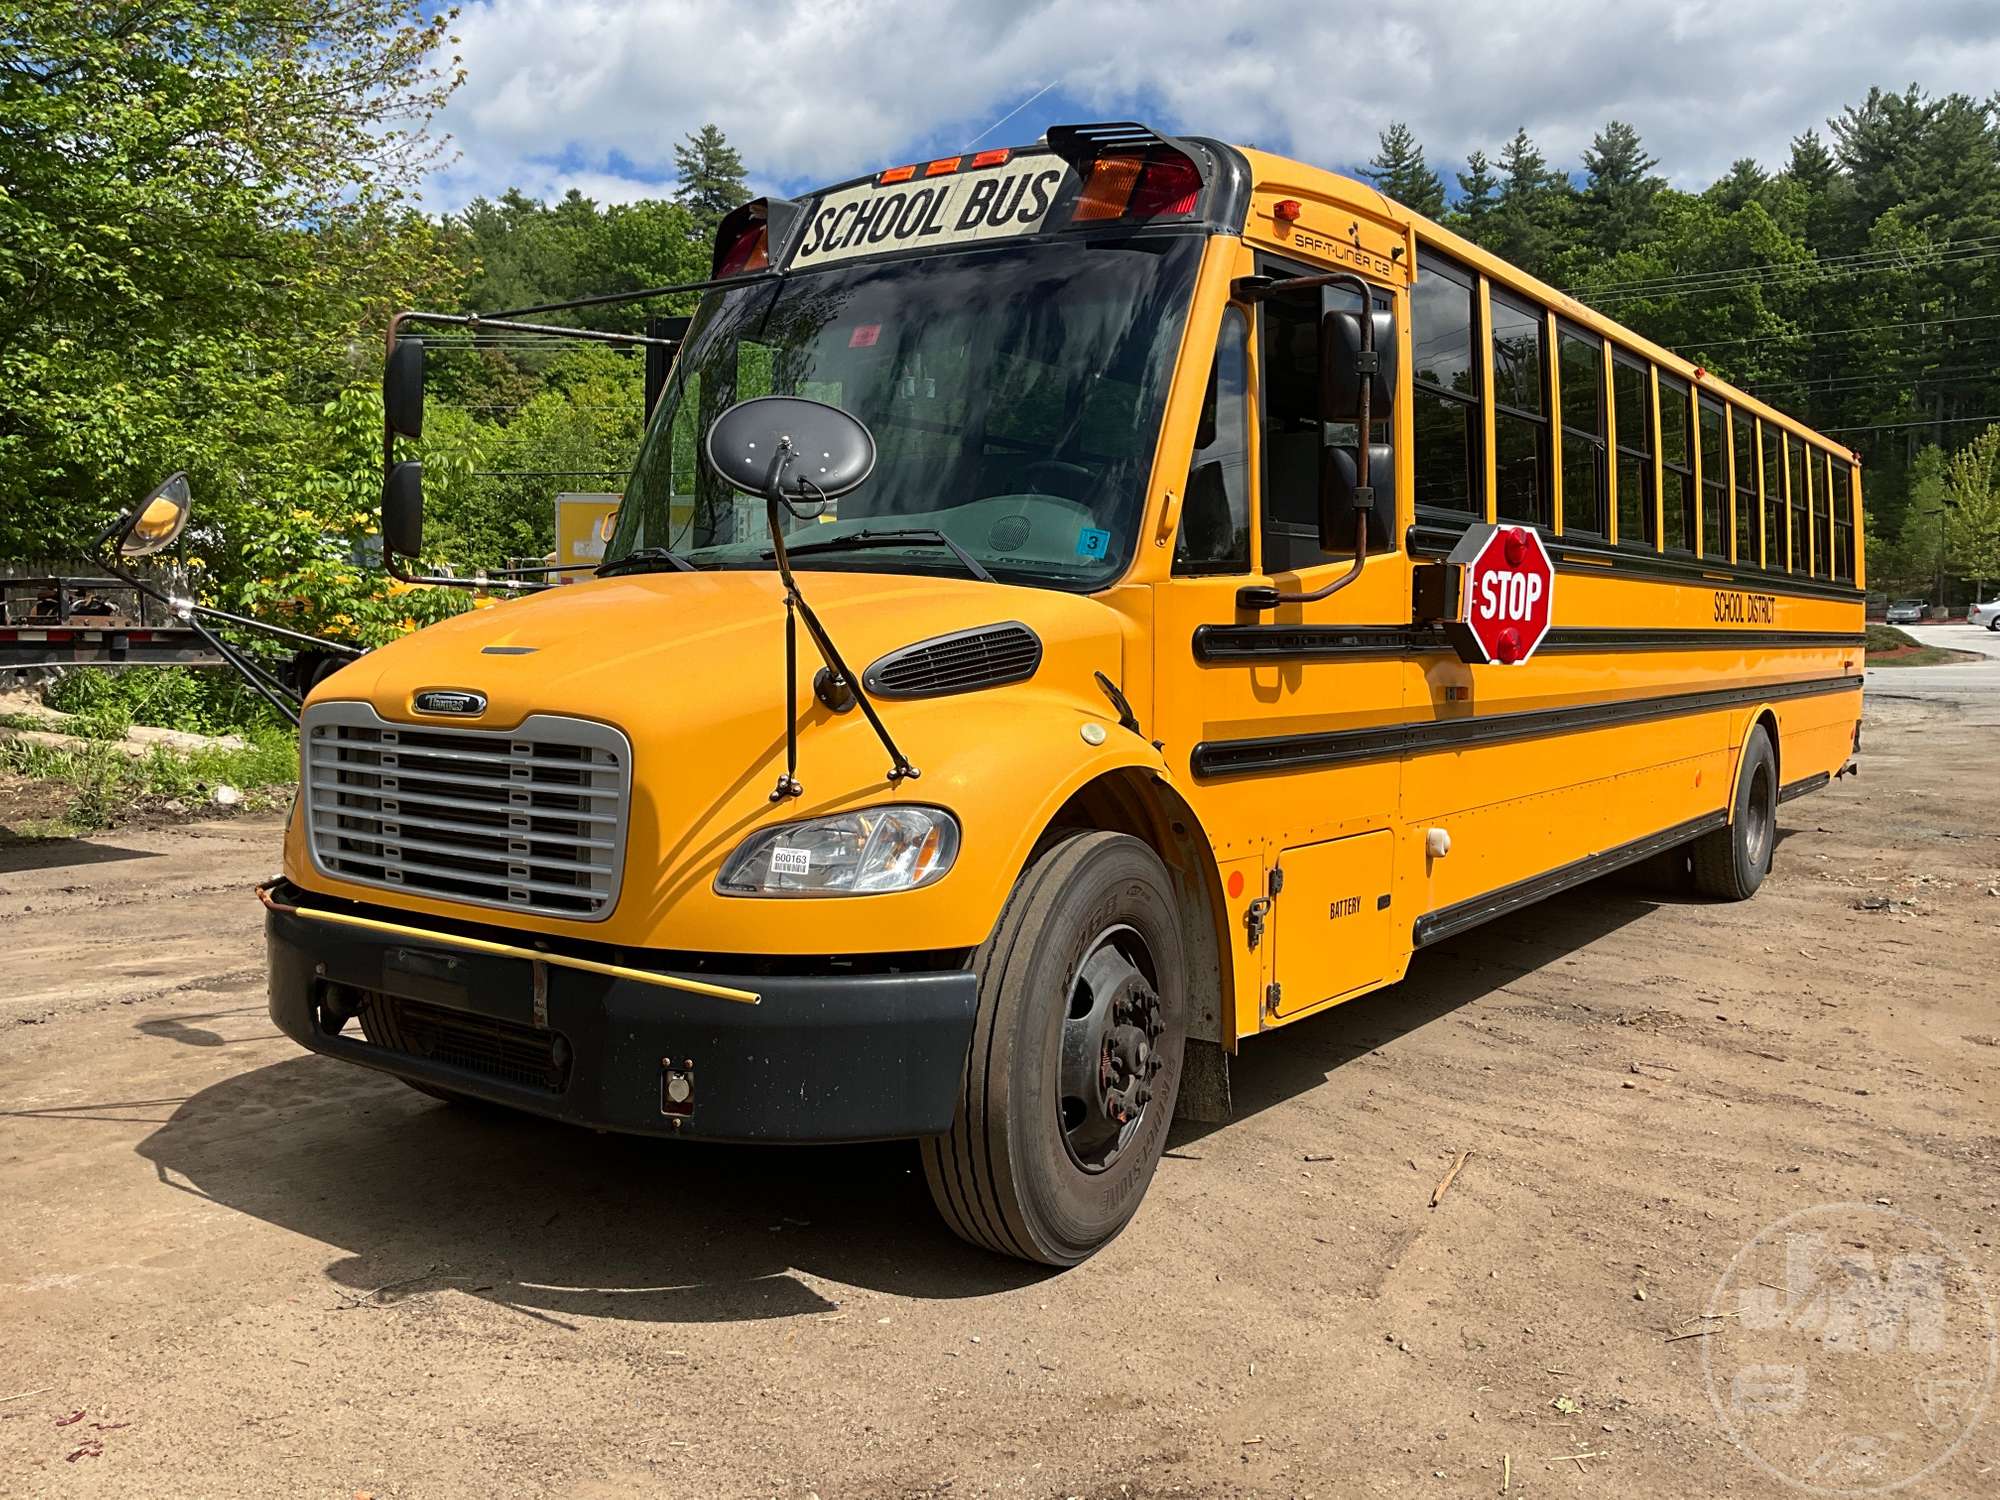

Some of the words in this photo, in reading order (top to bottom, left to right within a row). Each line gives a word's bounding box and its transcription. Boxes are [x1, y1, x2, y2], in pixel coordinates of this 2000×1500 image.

[801, 186, 950, 257] SCHOOL
[954, 170, 1060, 232] BUS
[1374, 260, 1391, 276] C2
[1087, 536, 1098, 550] 3
[1480, 570, 1542, 622] STOP
[1714, 591, 1744, 623] SCHOOL
[1747, 593, 1776, 625] DISTRICT
[775, 853, 808, 865] 600163
[1329, 895, 1362, 920] BATTERY
